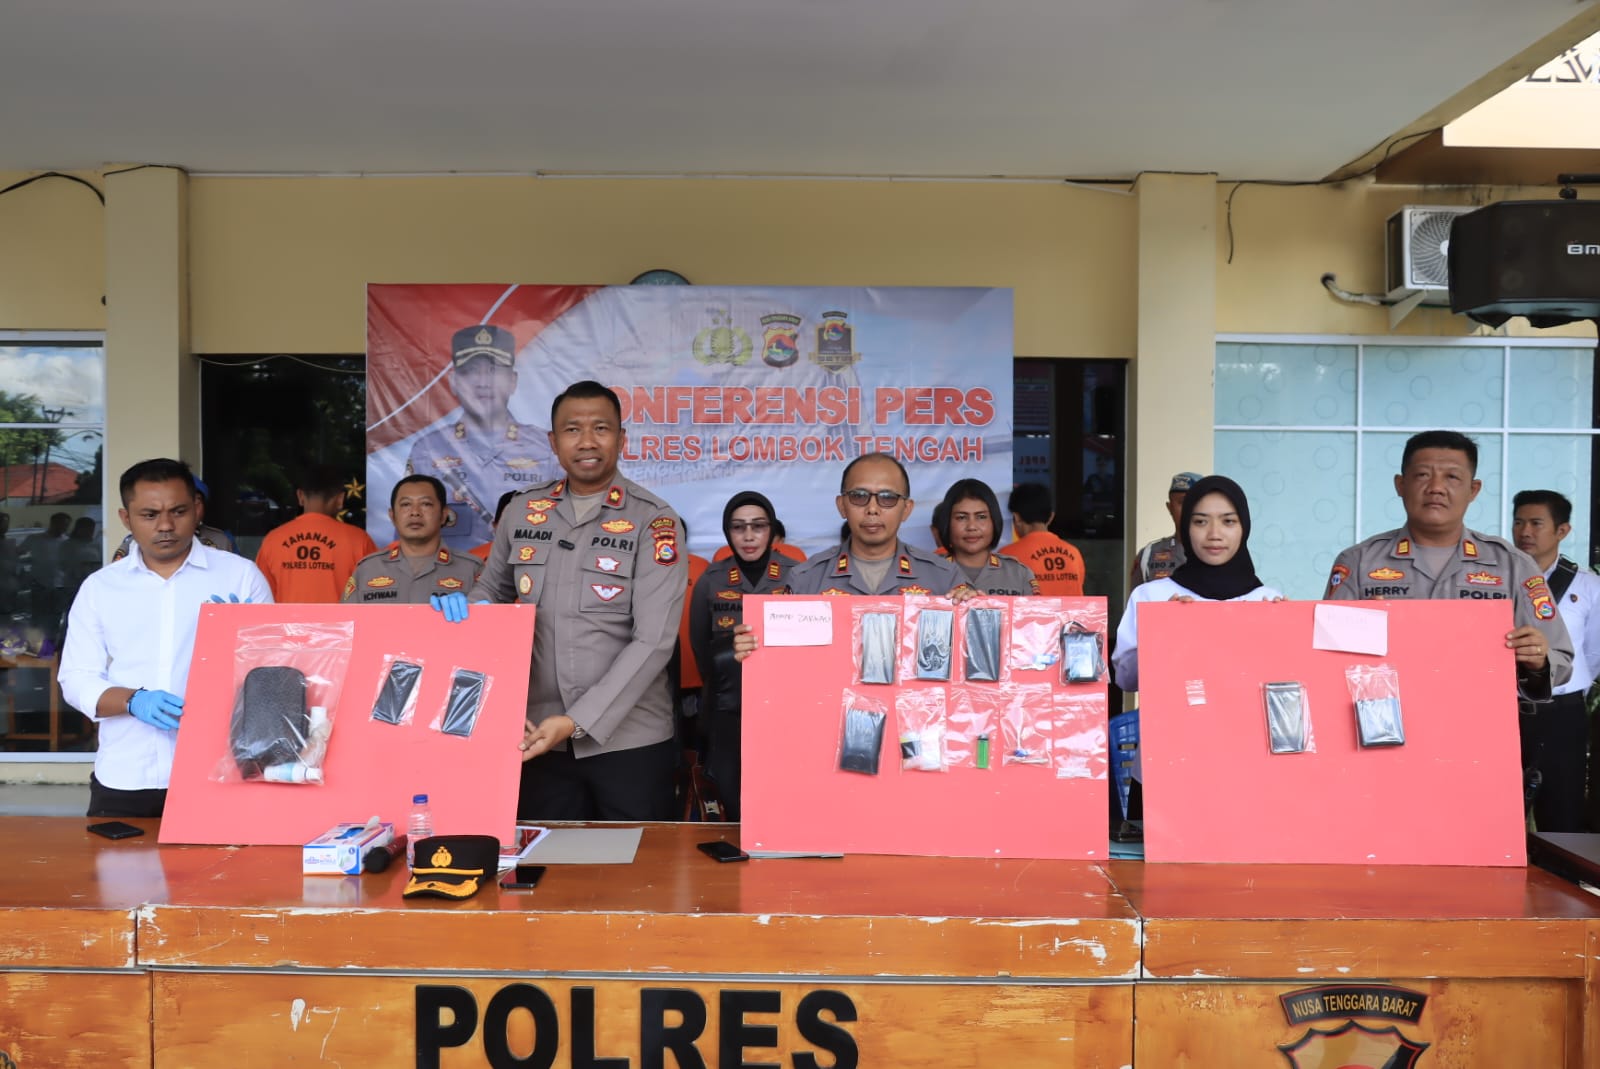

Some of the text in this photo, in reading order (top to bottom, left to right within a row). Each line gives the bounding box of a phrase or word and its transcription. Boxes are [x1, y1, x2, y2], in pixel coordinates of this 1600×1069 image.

[875, 387, 994, 426] PERS
[623, 435, 983, 463] LRES LOMBOK TENGAH
[282, 532, 336, 549] TAHANAN
[513, 528, 552, 541] MALADI
[591, 537, 634, 551] POLRI
[296, 545, 320, 560] 06
[1031, 546, 1075, 561] TAHANAN
[1044, 557, 1065, 571] 09
[1365, 586, 1410, 597] HERRY
[1292, 994, 1418, 1018] NUSA TENGGARA BARAT
[415, 983, 859, 1069] POLRES
